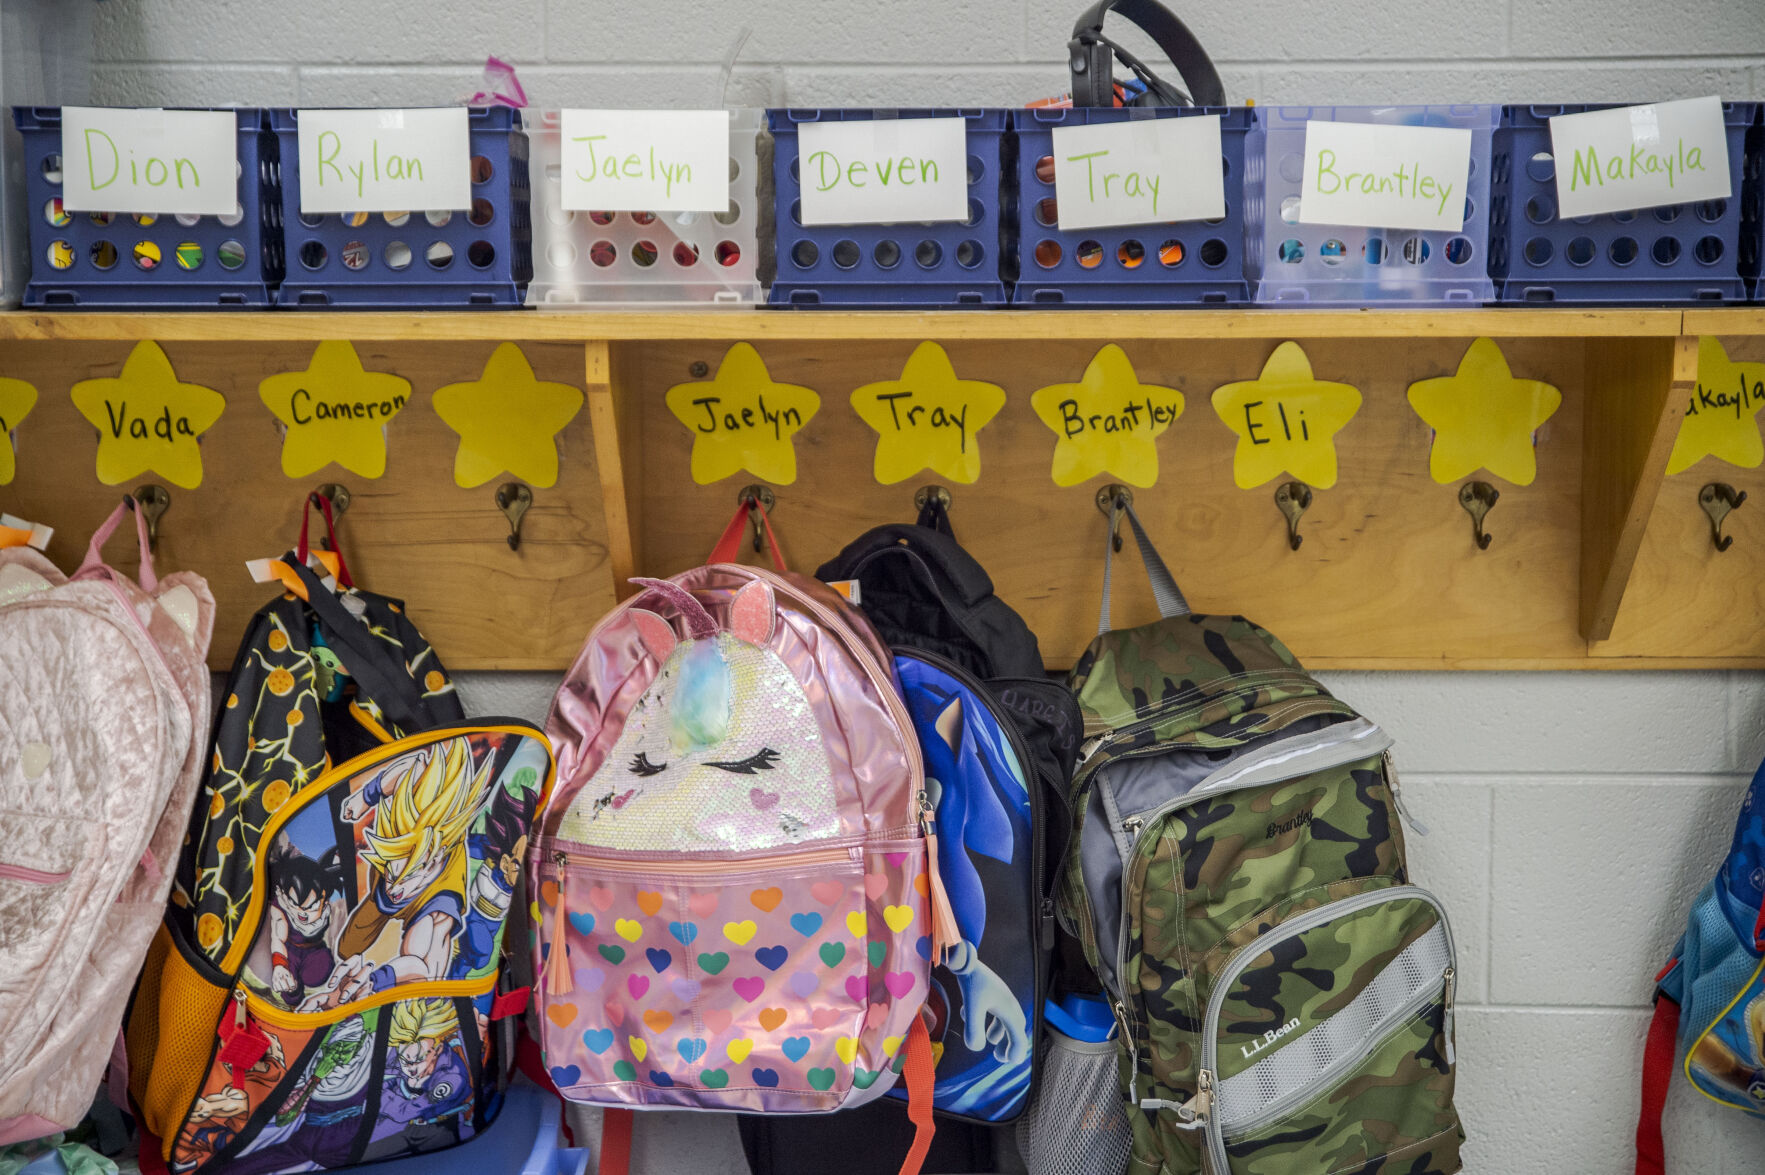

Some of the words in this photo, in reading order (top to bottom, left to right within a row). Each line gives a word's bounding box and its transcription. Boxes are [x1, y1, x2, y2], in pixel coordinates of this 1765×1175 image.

[84, 128, 200, 192] Dion
[317, 130, 424, 199] Rylan
[572, 135, 692, 199] Jaelyn
[807, 151, 939, 192] Deven
[1066, 149, 1160, 216] Tray
[1317, 149, 1453, 217] Brantley
[1570, 138, 1706, 193] Makayla
[290, 388, 406, 425] Cameron
[692, 394, 802, 442] Jaelyn
[1058, 397, 1177, 440] Brantley
[1684, 372, 1765, 420] akayla
[104, 399, 195, 444] Vada
[876, 391, 968, 455] Tray
[1243, 401, 1310, 445] Eli
[1265, 807, 1314, 840] Brantley
[1240, 1017, 1301, 1059] L.L.Bean
